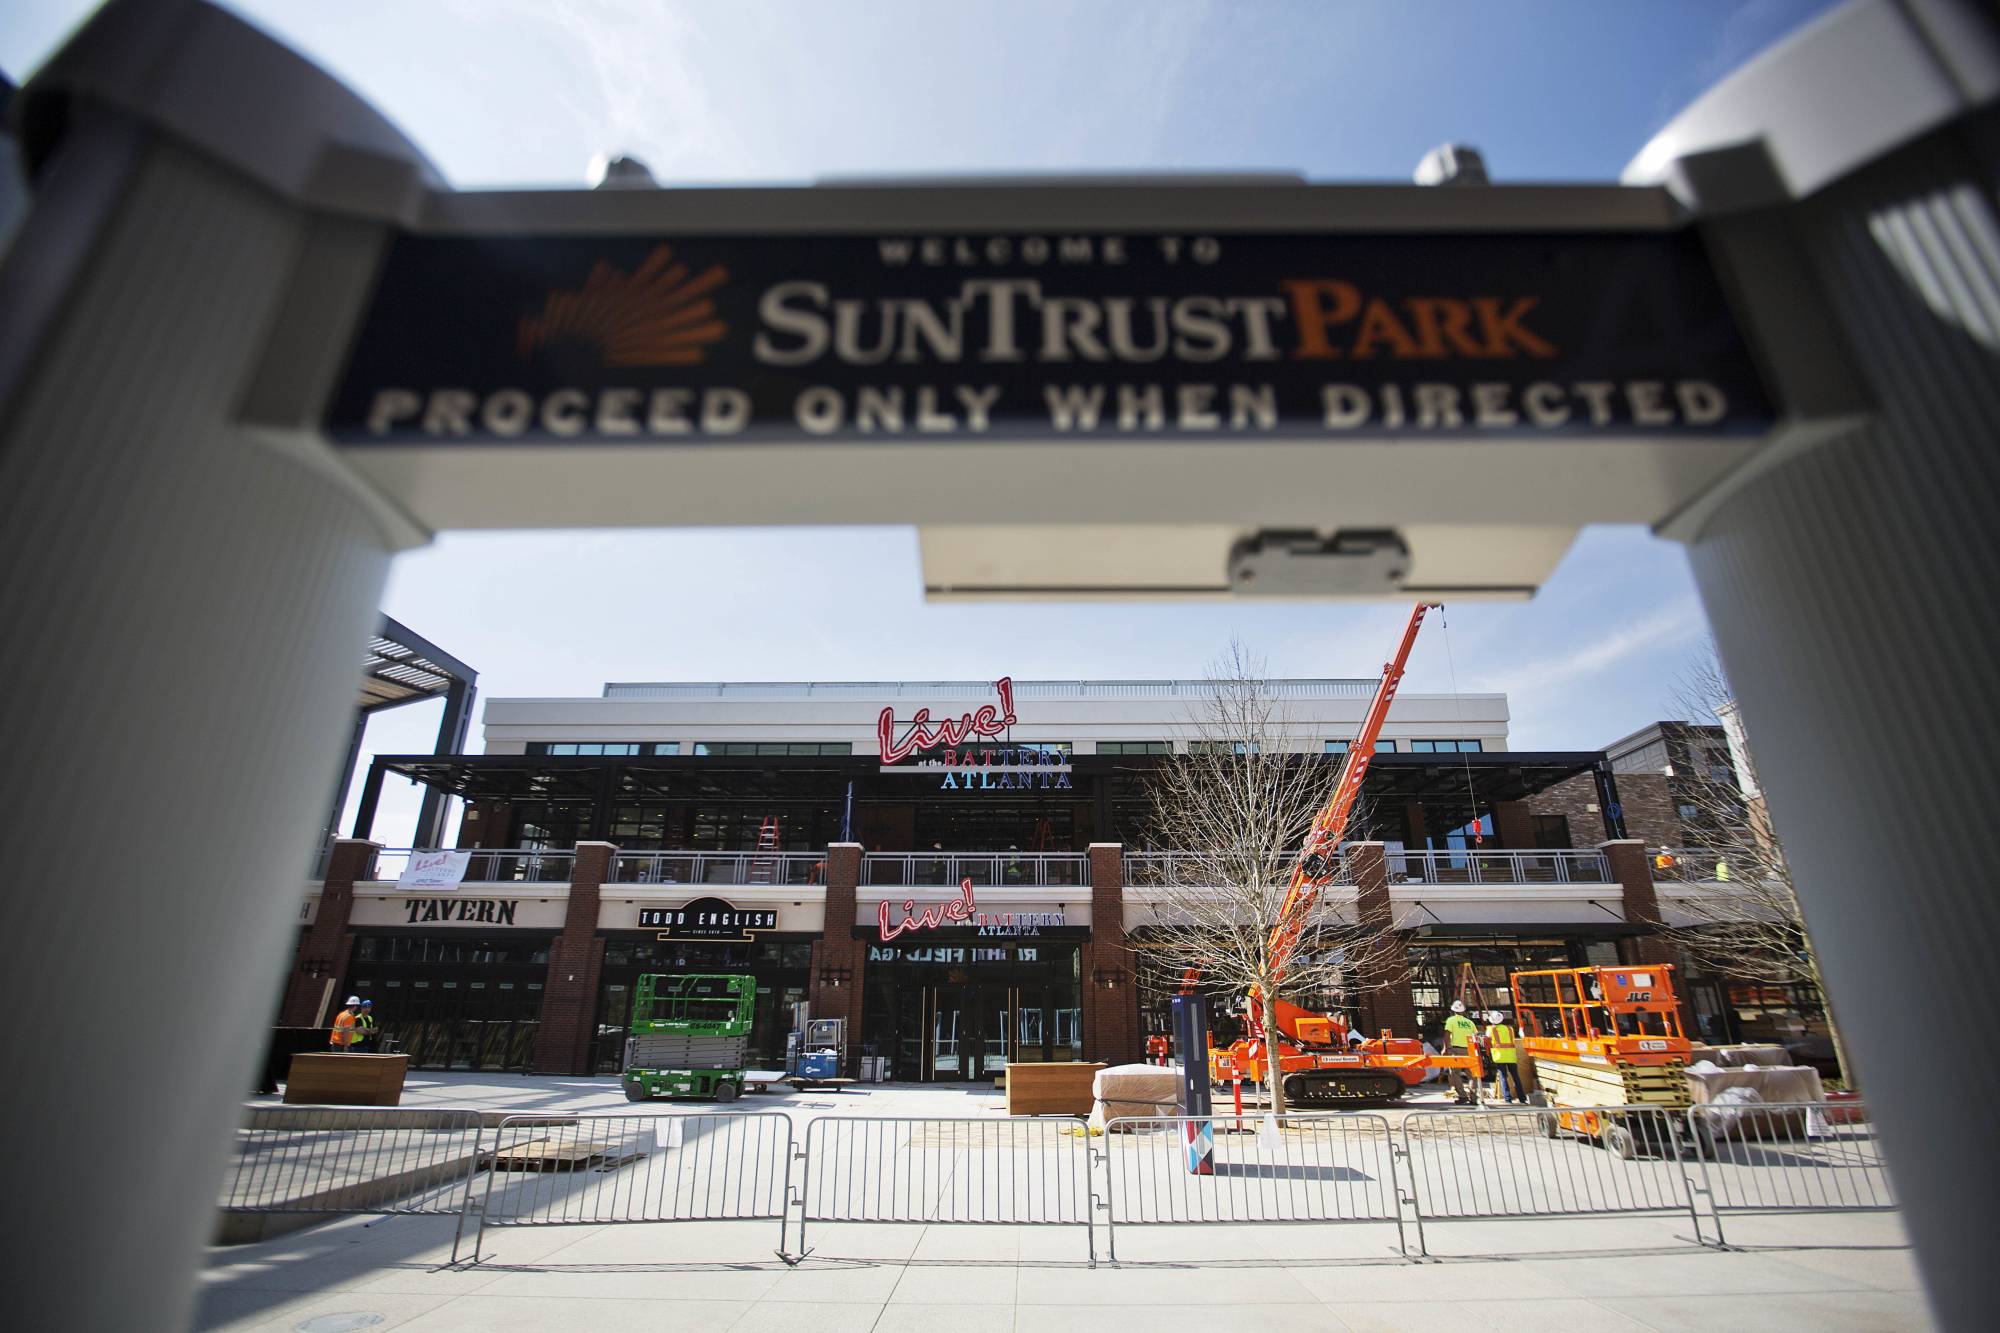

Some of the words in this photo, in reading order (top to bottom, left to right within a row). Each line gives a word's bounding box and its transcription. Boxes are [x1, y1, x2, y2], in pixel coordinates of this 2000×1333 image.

[878, 238, 1126, 266] WELCOME
[1161, 238, 1221, 264] TO
[366, 389, 750, 436] PROCEED
[794, 387, 1001, 436] ONLY
[1046, 385, 1278, 431] WHEN
[1322, 381, 1728, 428] DIRECTED
[878, 676, 1017, 766] Live!
[942, 749, 1070, 766] BATTERY
[940, 771, 1073, 789] ATLANTA
[405, 899, 519, 925] TAVERN
[879, 878, 976, 941] Live!
[642, 912, 685, 925] TODD
[699, 914, 774, 926] ENGLISH
[977, 913, 1065, 926] BATTERY
[978, 926, 1040, 936] ATLANTA
[1626, 992, 1651, 1002] JLG
